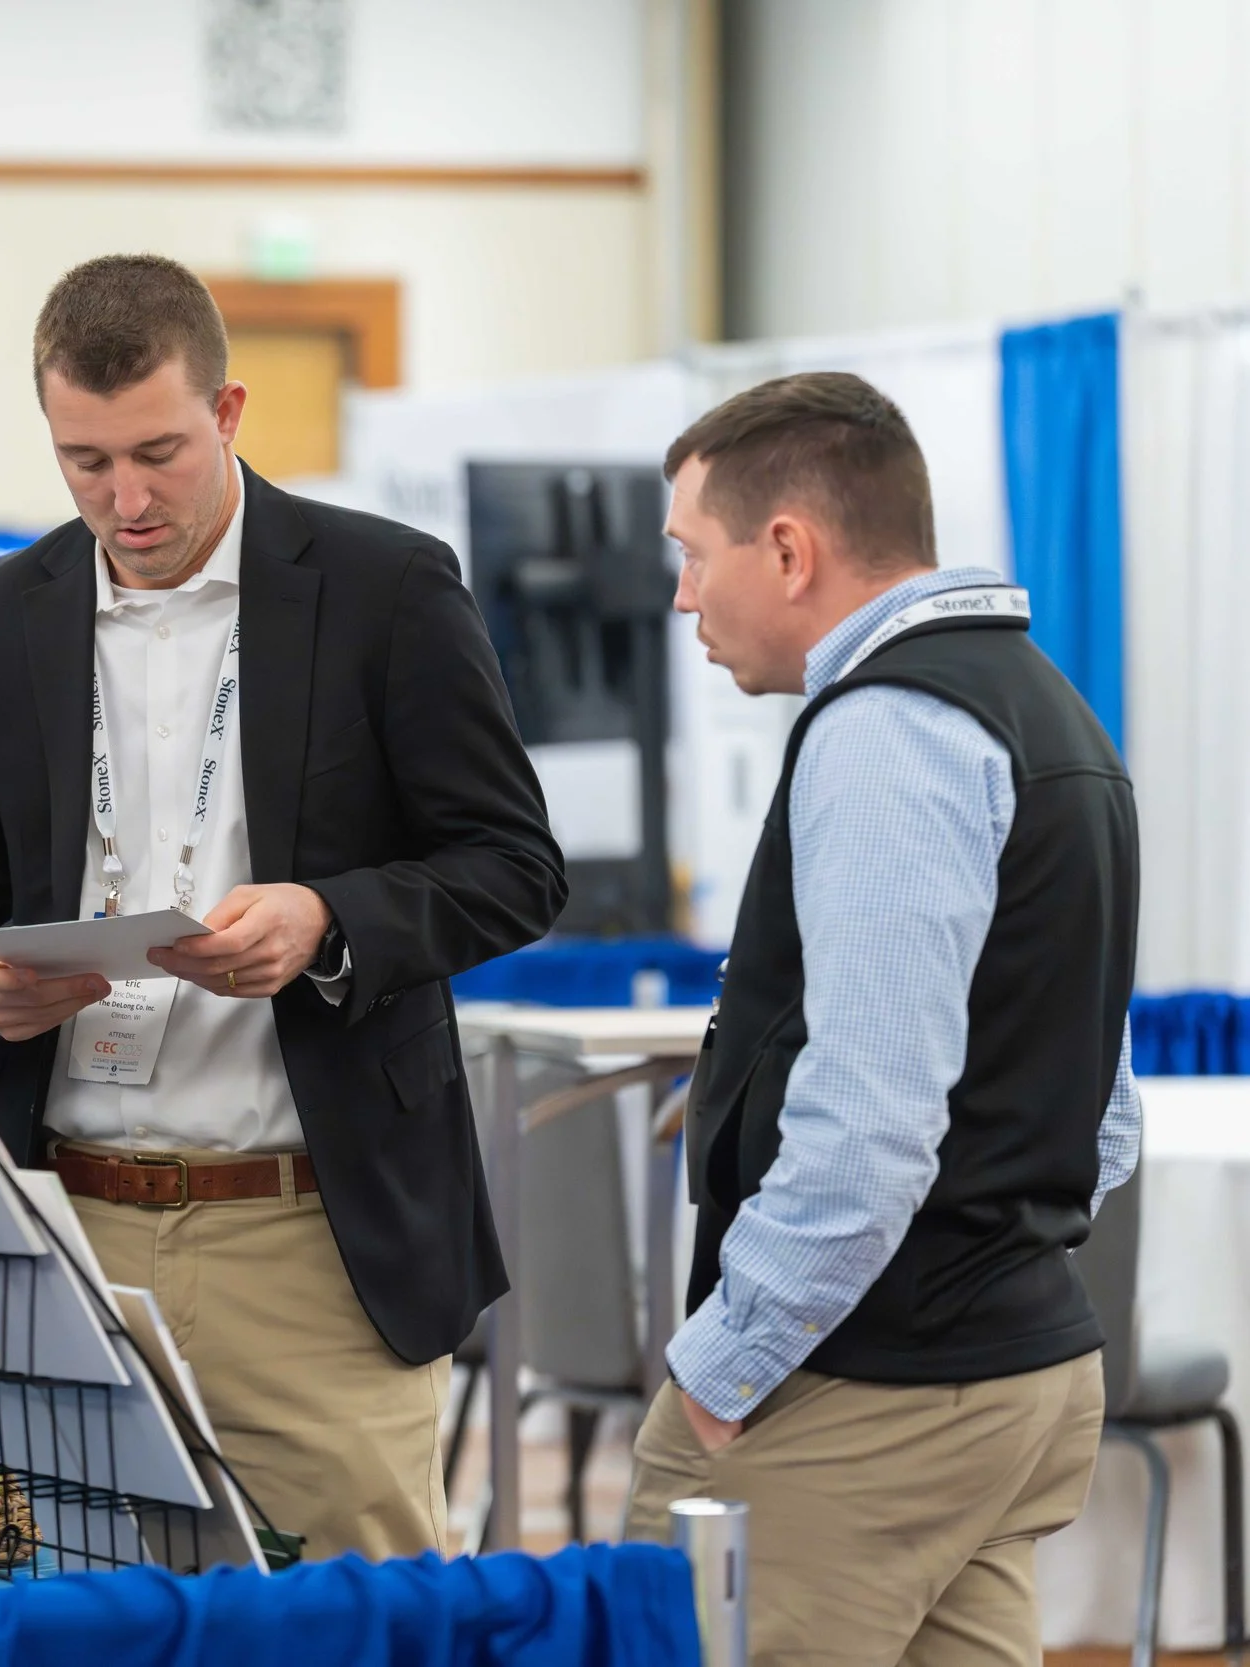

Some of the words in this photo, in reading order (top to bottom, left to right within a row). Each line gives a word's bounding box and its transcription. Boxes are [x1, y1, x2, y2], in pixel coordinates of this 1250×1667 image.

[932, 595, 997, 614] StoneX
[210, 677, 237, 738] StoneX
[92, 751, 112, 813] StoneX
[195, 758, 217, 820] StoneX
[125, 979, 141, 988] Eric
[114, 990, 124, 998] Eric
[125, 992, 147, 1001] DeLong
[111, 1001, 135, 1011] DeLong
[108, 1031, 137, 1040] ATTENDEE
[94, 1040, 118, 1054] CEC
